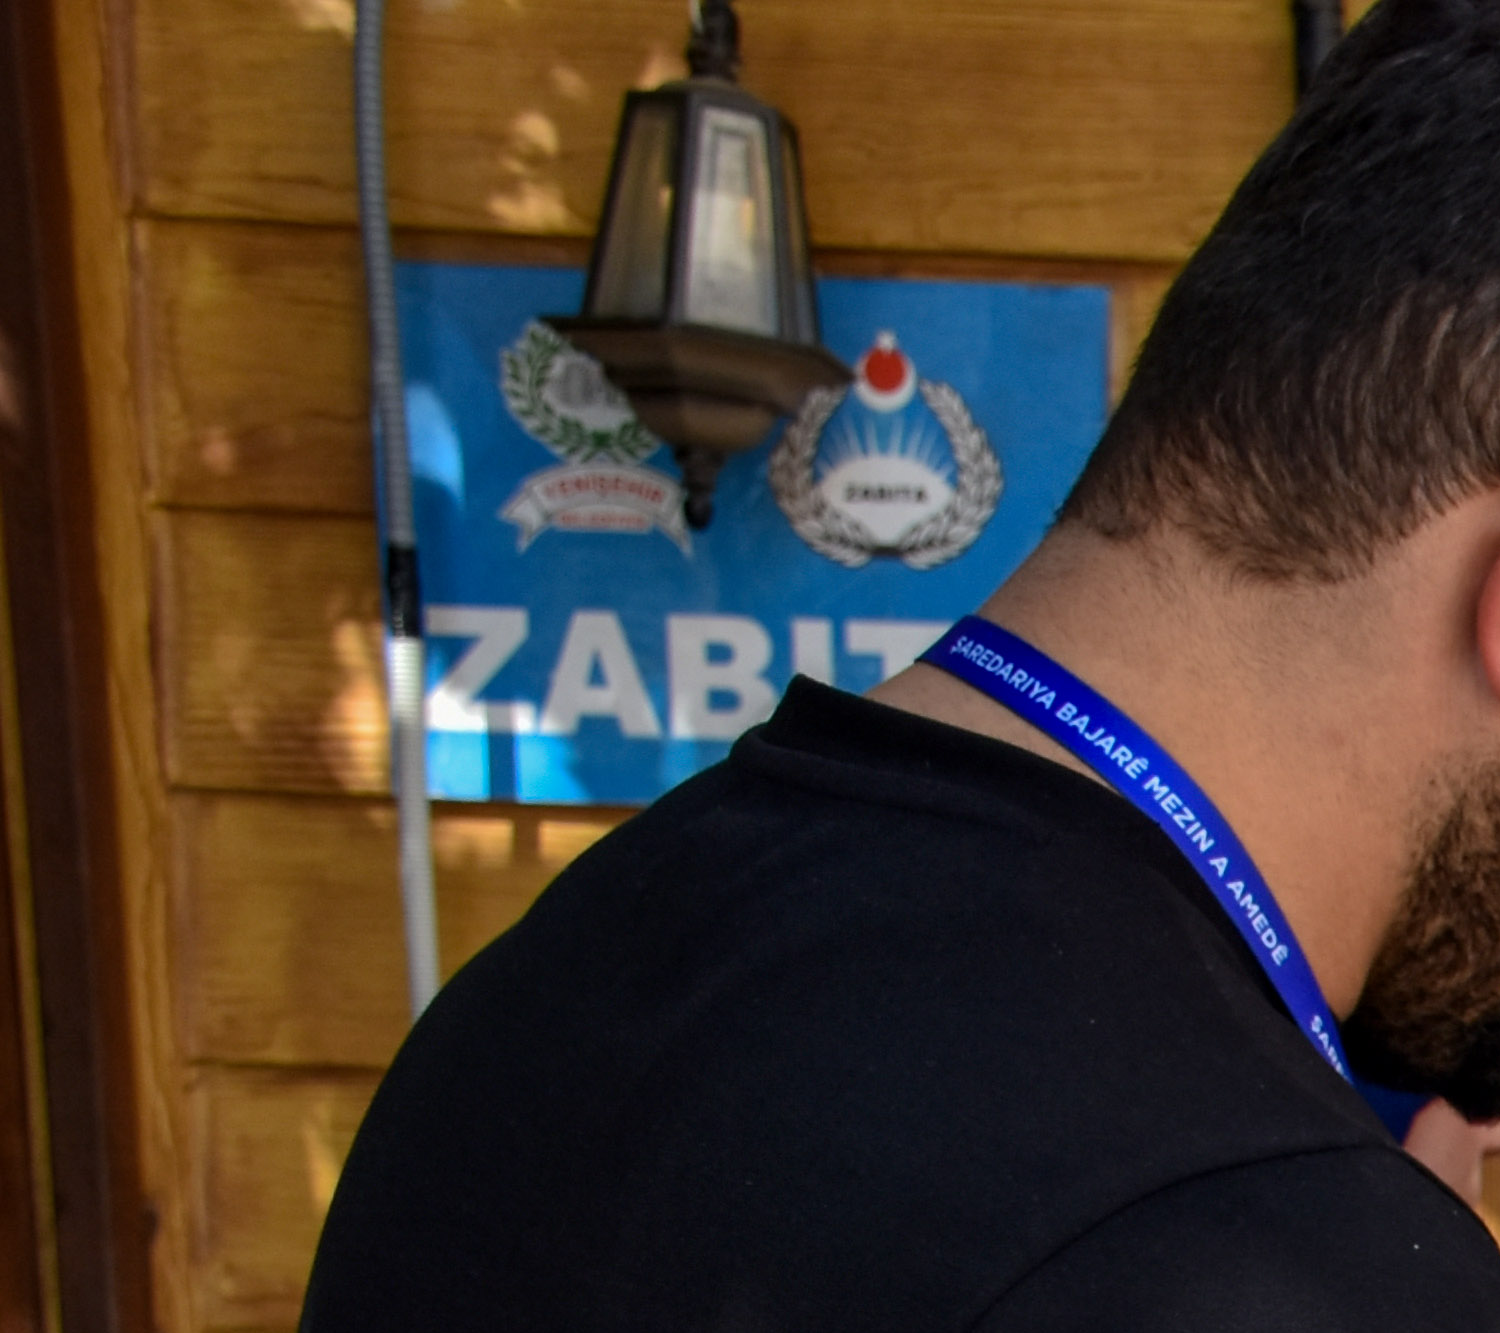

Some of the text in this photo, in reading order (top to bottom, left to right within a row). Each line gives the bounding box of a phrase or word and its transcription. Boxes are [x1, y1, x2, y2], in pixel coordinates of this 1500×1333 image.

[1055, 702, 1150, 780] BAJARÊ
[1143, 775, 1215, 852] MEZIN
[1208, 856, 1229, 878] A
[1226, 880, 1289, 967] AMEDÊ
